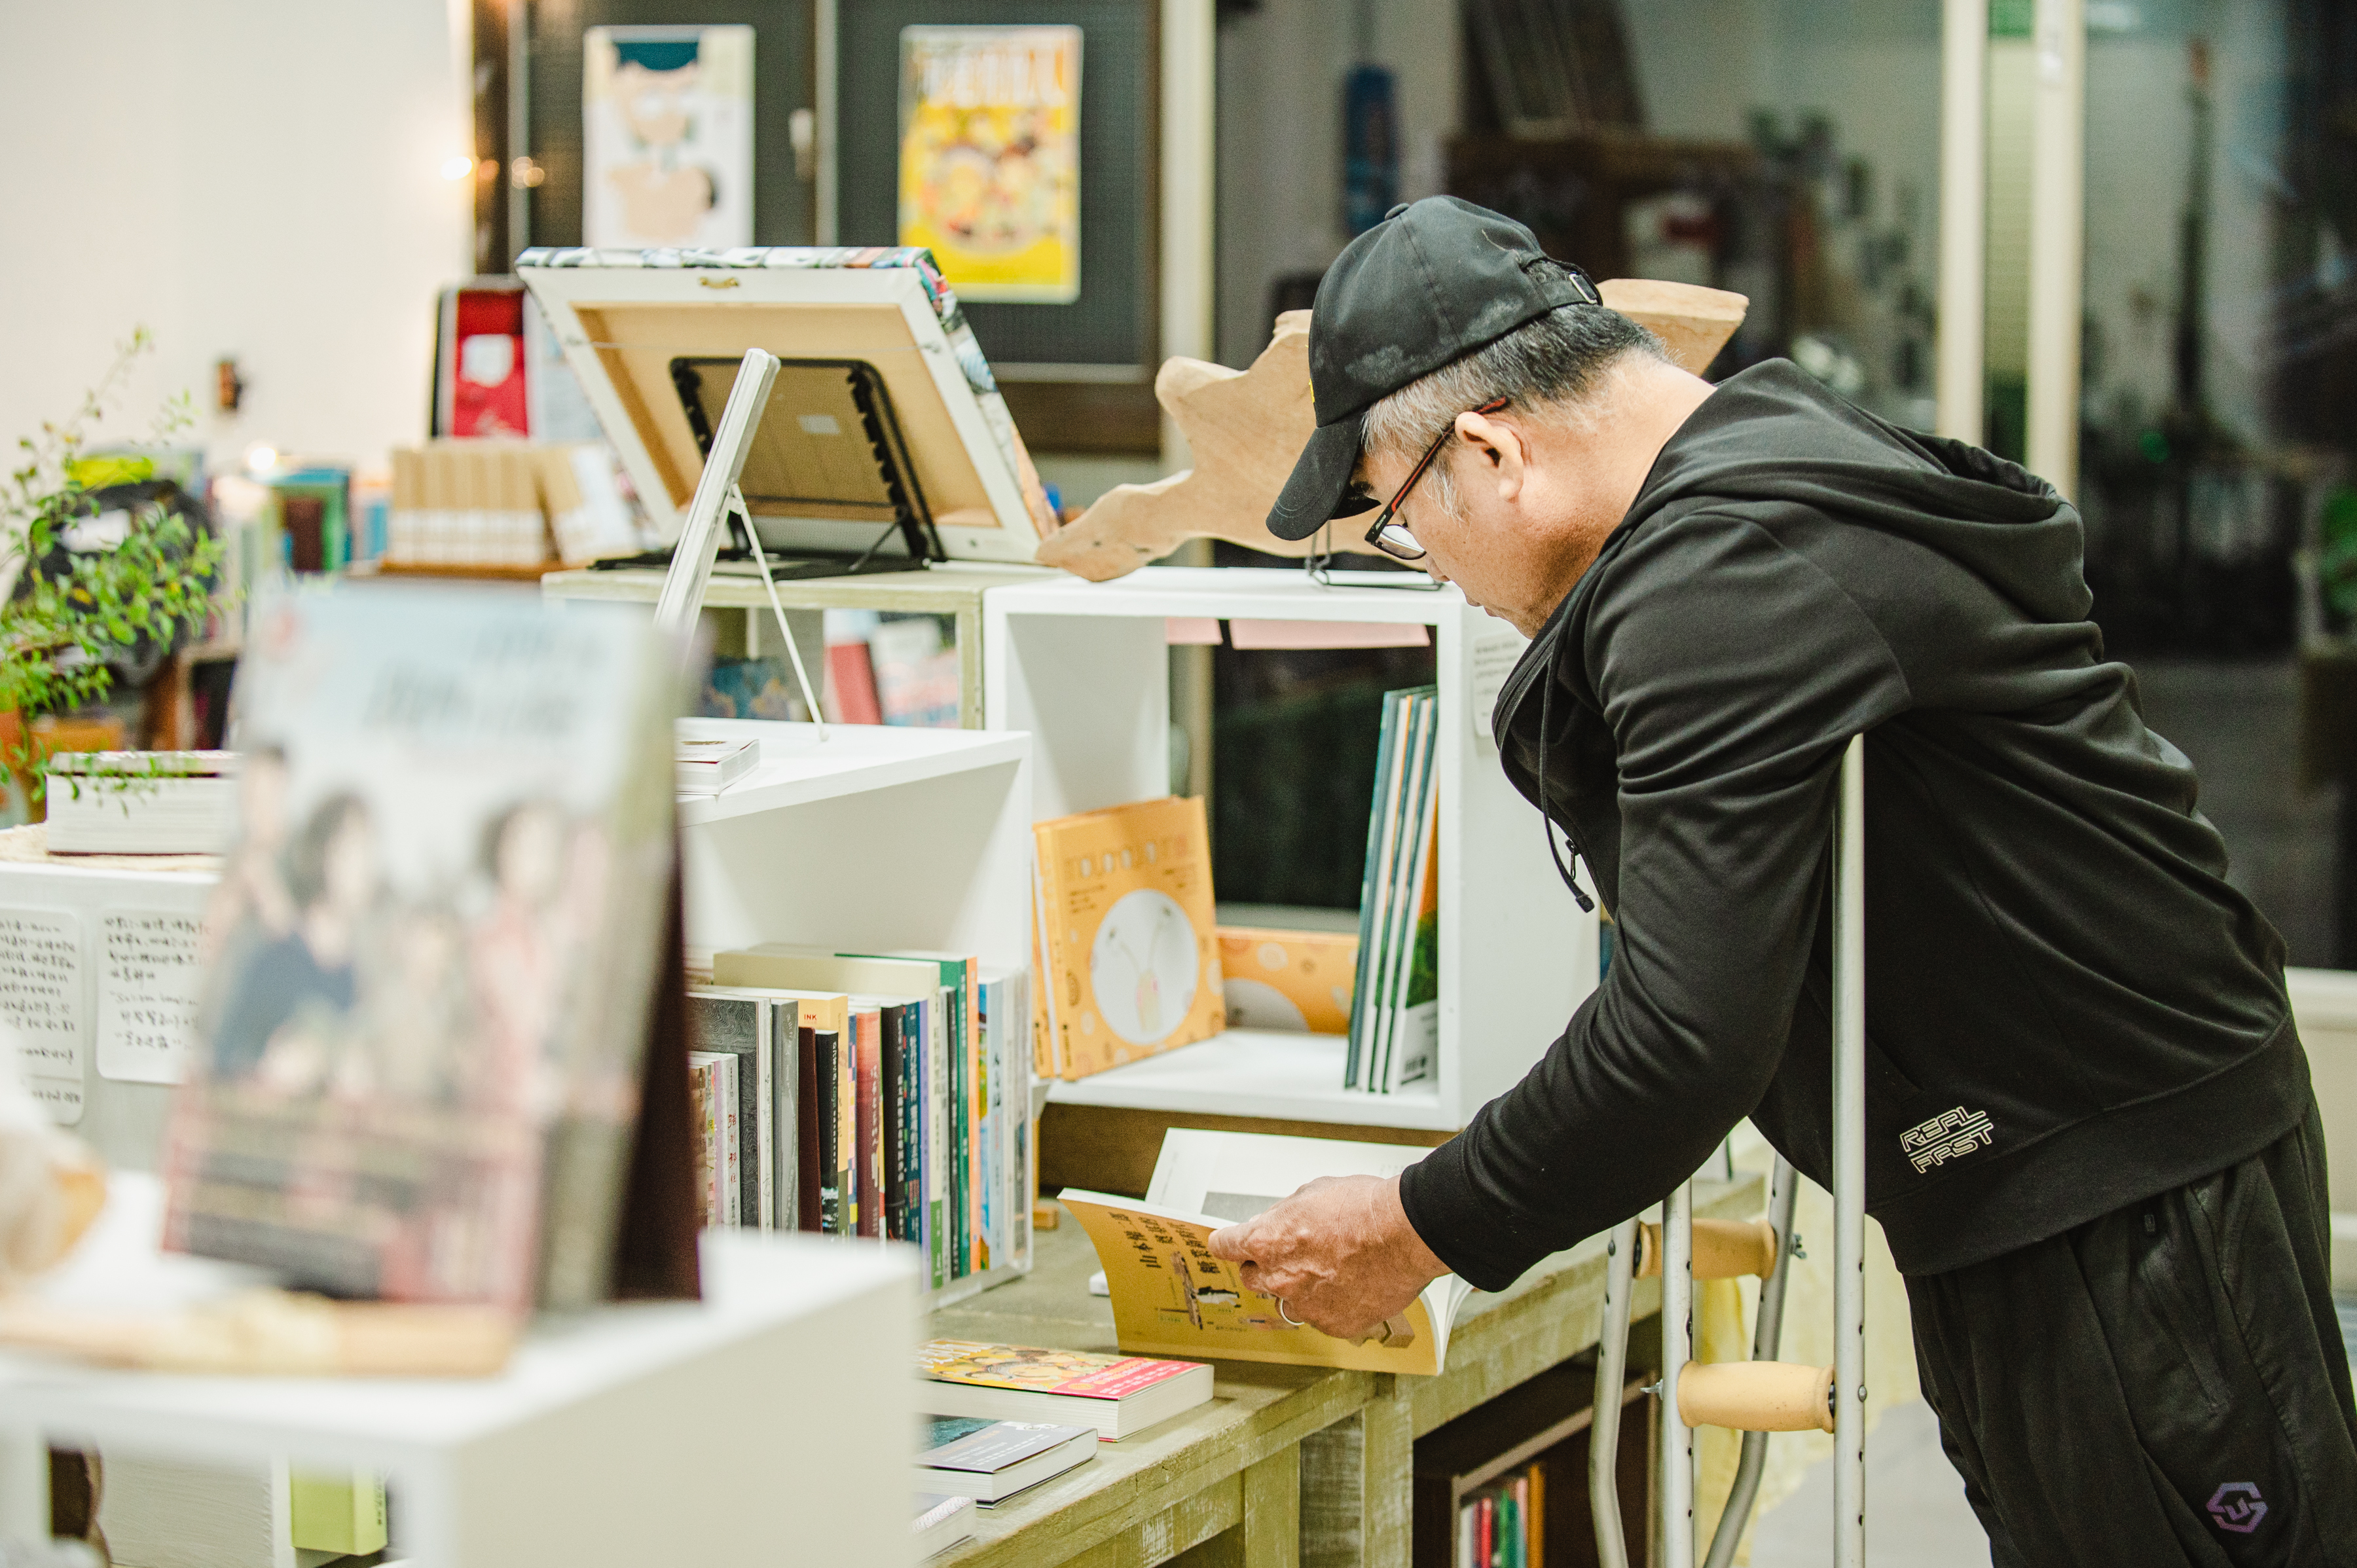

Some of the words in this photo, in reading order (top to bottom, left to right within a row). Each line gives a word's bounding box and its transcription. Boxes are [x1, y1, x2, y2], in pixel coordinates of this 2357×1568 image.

[728, 1110, 737, 1184] 強制移住
[1899, 1106, 1986, 1152] REAL
[1910, 1122, 1994, 1174] FAST
